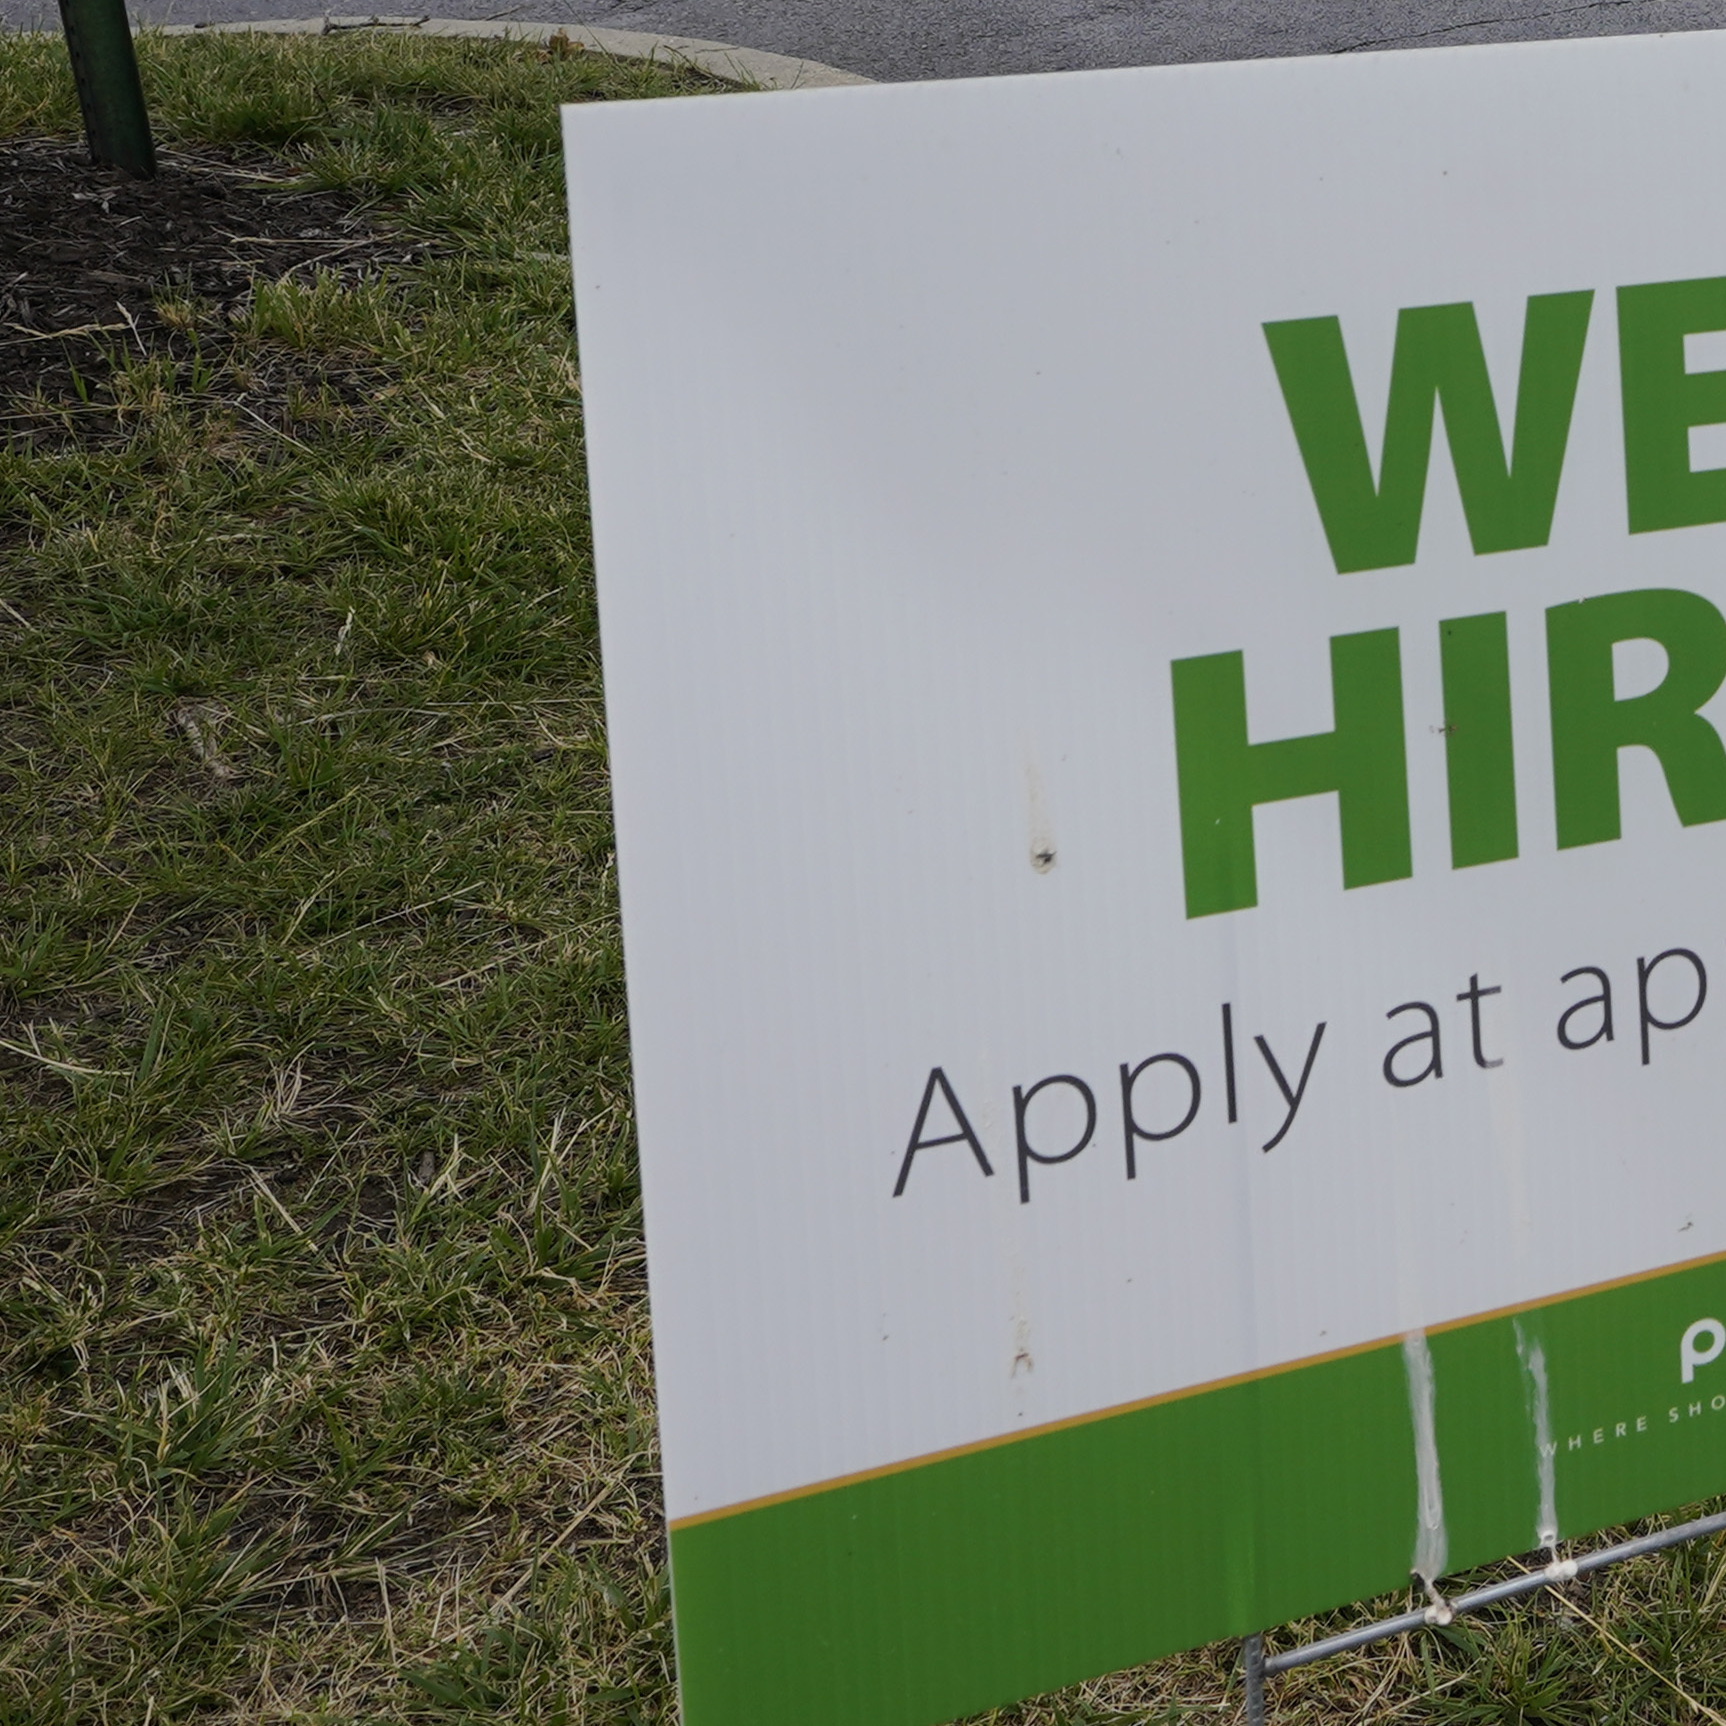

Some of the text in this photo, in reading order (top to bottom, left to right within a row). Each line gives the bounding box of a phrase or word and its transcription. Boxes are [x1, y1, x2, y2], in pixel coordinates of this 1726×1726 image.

[892, 1002, 1328, 1205] Apply
[1382, 973, 1502, 1089] at
[1539, 1416, 1648, 1458] WHERE
